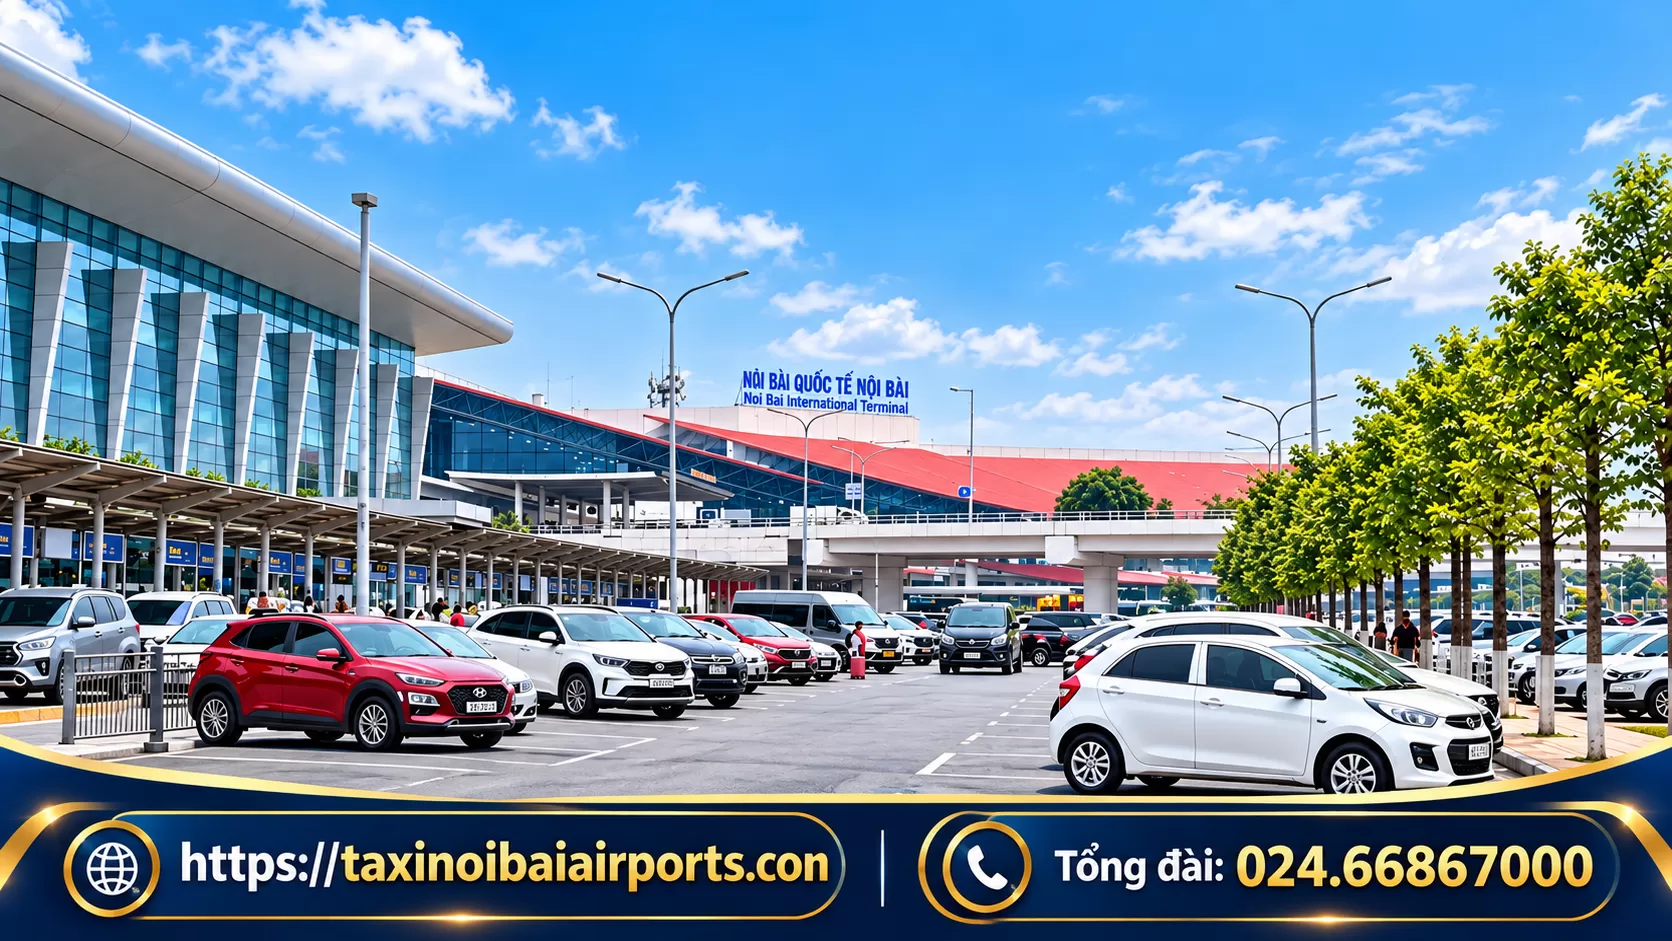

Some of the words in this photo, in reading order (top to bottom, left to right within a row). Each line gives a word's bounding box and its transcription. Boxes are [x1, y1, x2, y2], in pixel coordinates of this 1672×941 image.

[769, 368, 790, 391] BÀI
[794, 369, 832, 394] QUỐC
[835, 370, 853, 395] TẾ
[856, 374, 881, 400] NỘI
[885, 376, 909, 398] BÀI
[743, 391, 763, 405] Noi
[766, 393, 784, 407] Bai
[787, 394, 857, 411] International
[860, 399, 909, 414] Terminal
